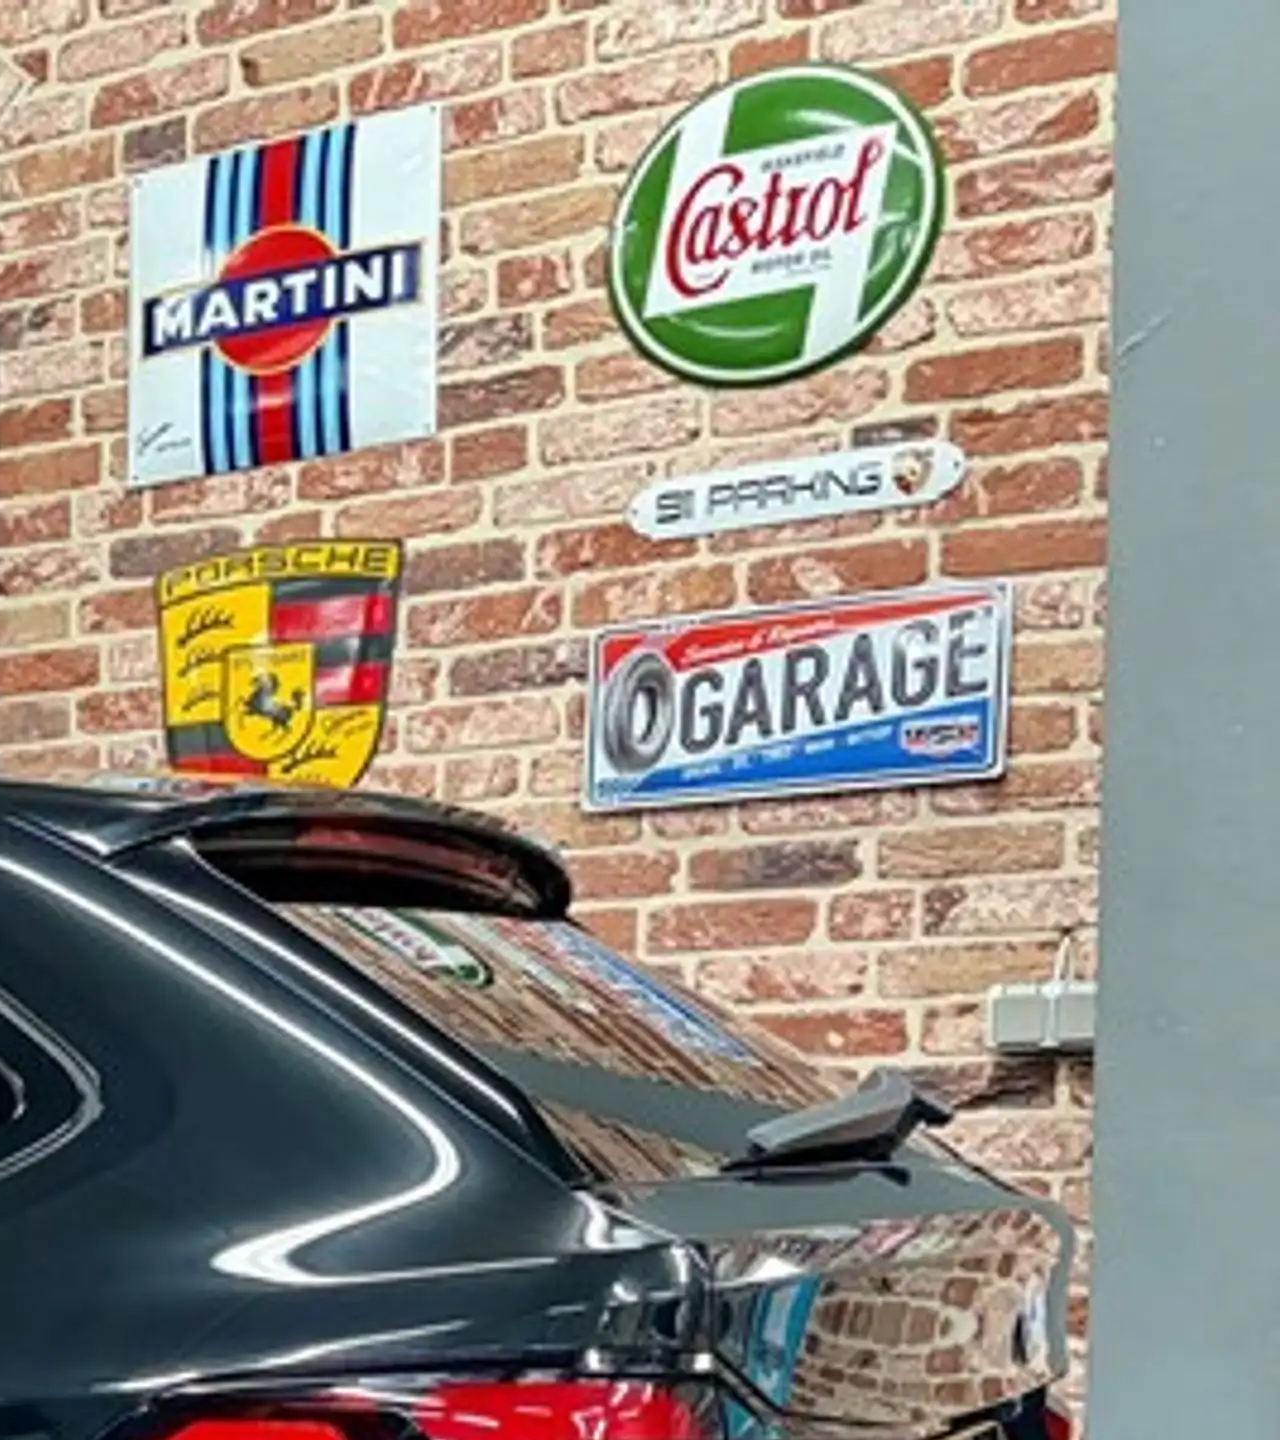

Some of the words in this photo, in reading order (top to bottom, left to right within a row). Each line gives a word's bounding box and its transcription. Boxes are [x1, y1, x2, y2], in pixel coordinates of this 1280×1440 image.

[665, 136, 884, 299] Castrol
[152, 251, 407, 347] MARTINI
[707, 461, 884, 515] PARKING
[163, 545, 390, 598] PORSCHE
[678, 606, 992, 755] GARAGE
